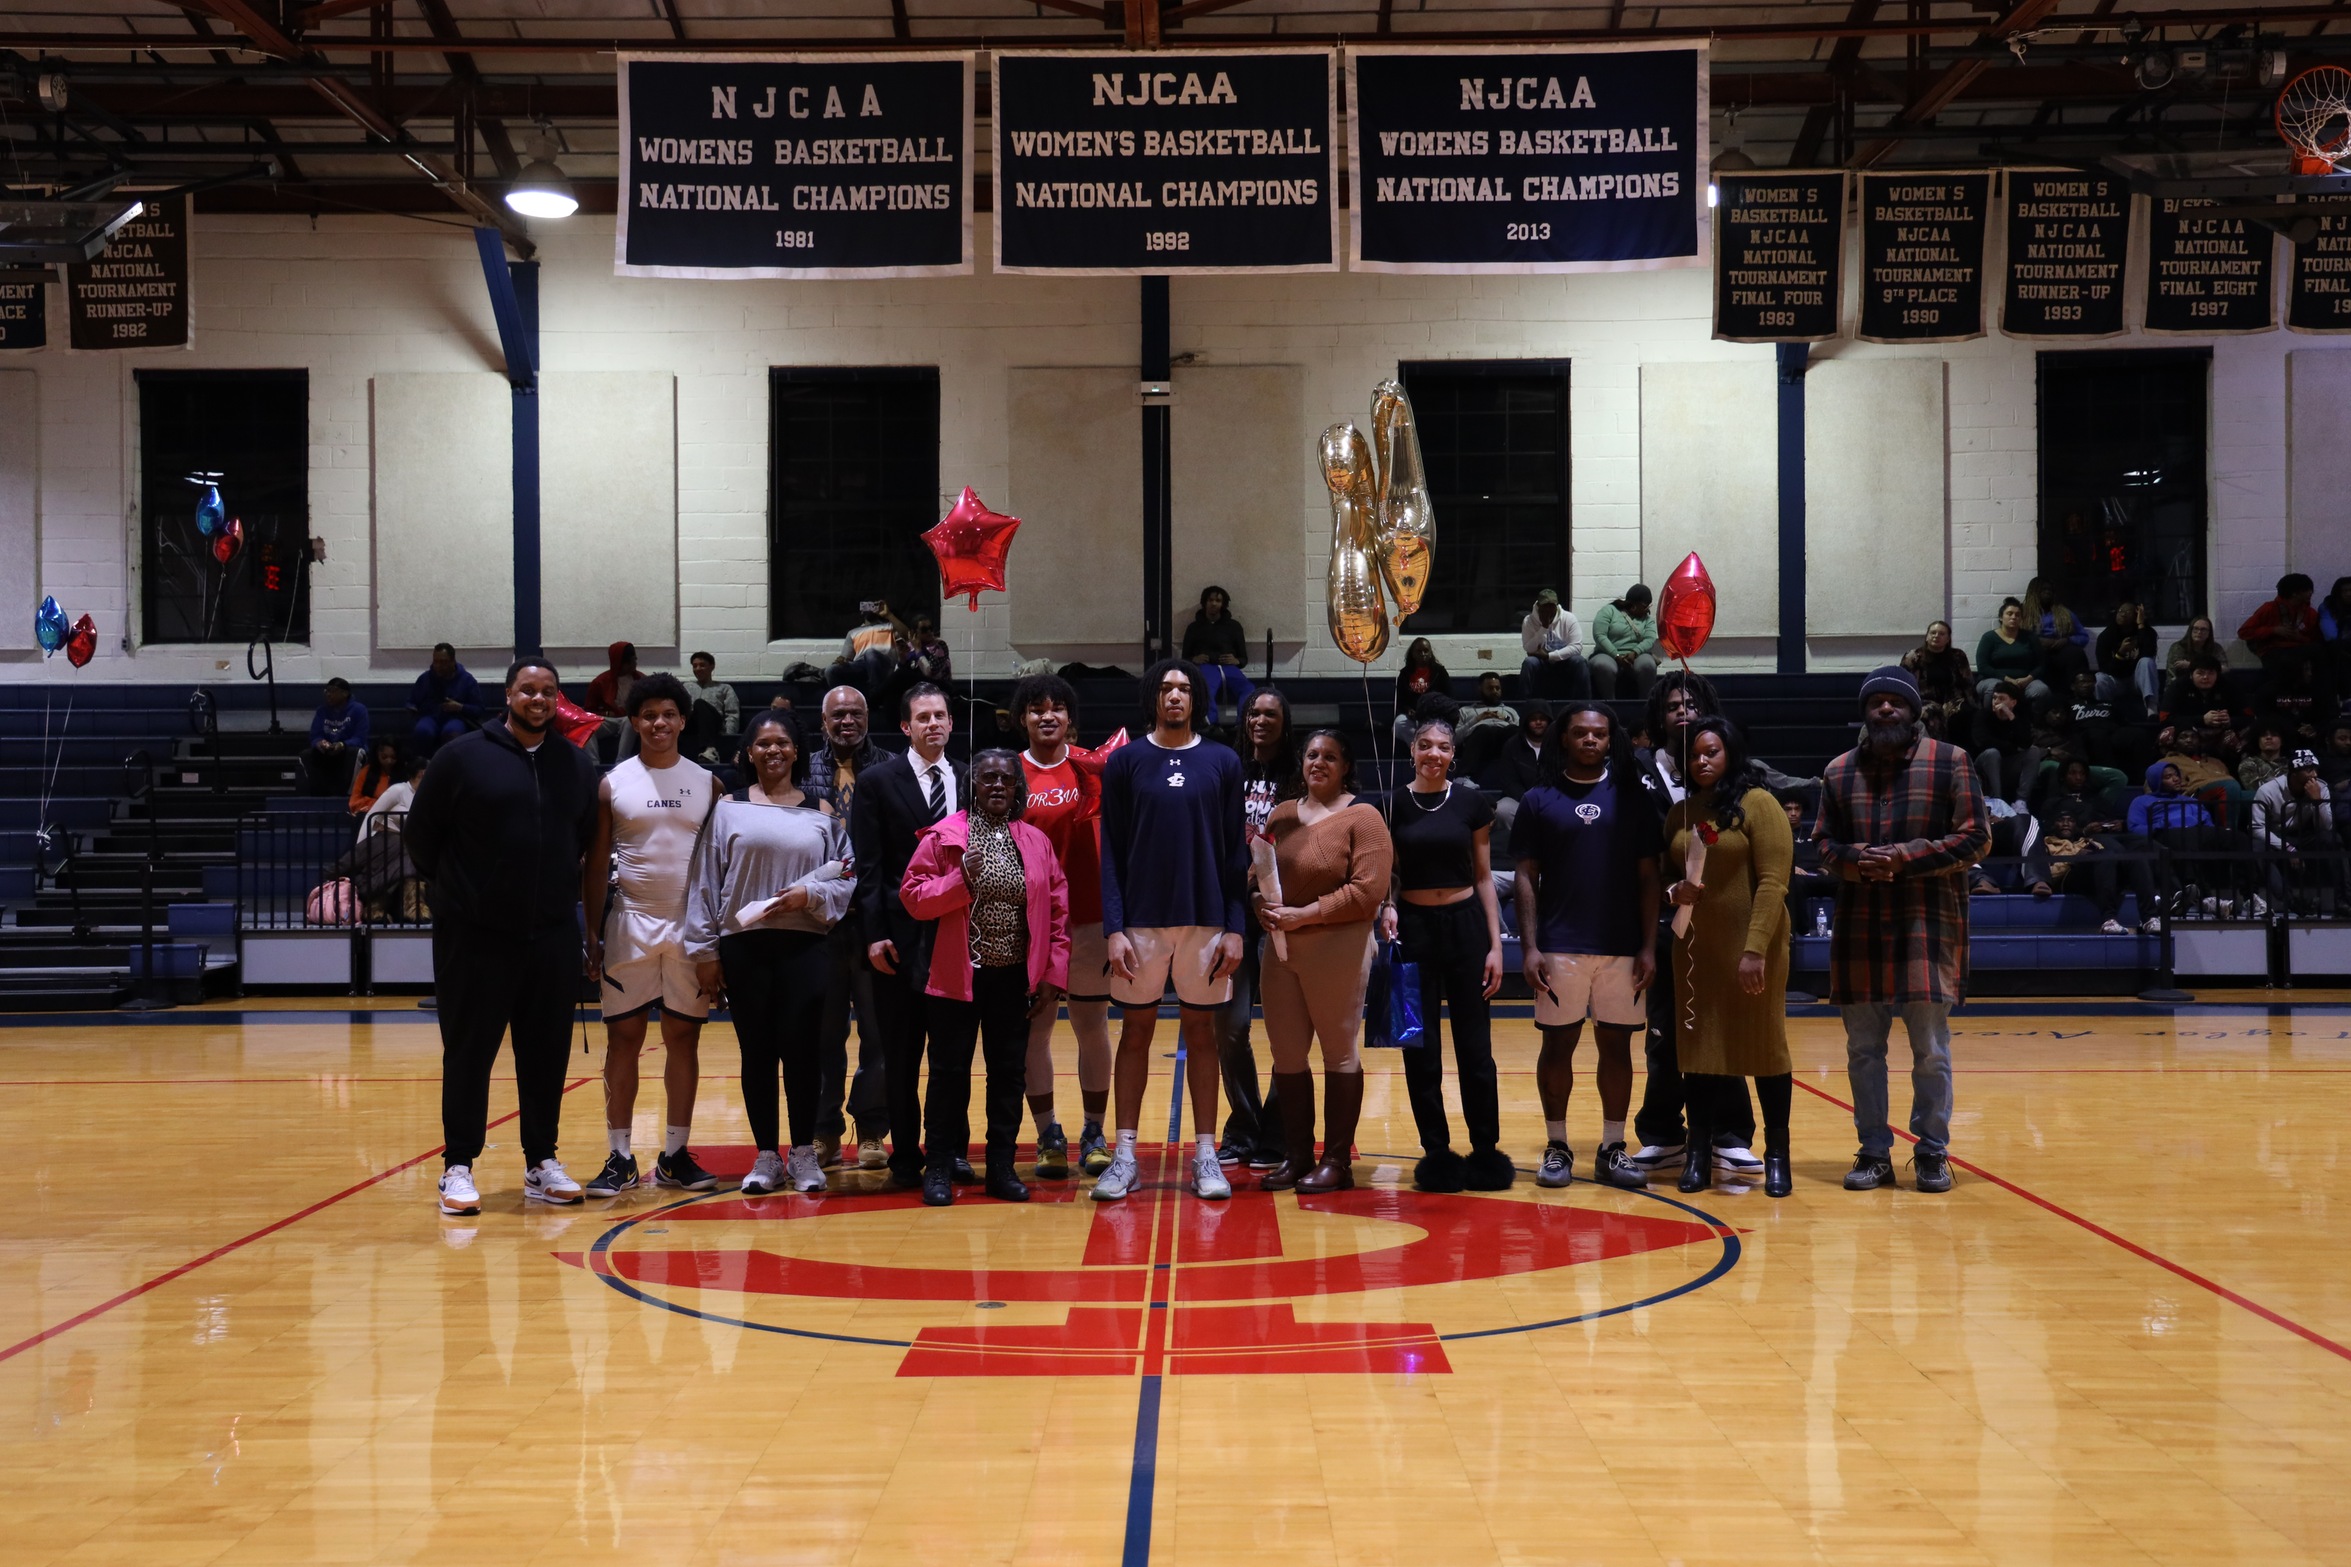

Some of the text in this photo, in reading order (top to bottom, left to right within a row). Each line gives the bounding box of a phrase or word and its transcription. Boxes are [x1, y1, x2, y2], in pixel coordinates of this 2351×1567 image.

[1093, 72, 1237, 106] NJCAA
[1460, 76, 1596, 111] NJCAA
[1011, 128, 1321, 157] WOMEN'S BASKETBALL
[1379, 127, 1678, 156] WOMENS BASKETBALL
[639, 137, 953, 165] WOMENS BASKETBALL
[1016, 179, 1318, 208] NATIONAL CHAMPIONS
[1376, 171, 1679, 202] NATIONAL CHAMPIONS
[640, 183, 949, 211] NATIONAL CHAMPIONS
[1731, 208, 1828, 224] BASKETBALL
[1875, 207, 1974, 222] BASKETBALL
[2018, 202, 2120, 218] BASKETBALL
[1507, 222, 1551, 241] 2013
[1750, 228, 1809, 244] NJCAA
[1897, 227, 1951, 242] NJCAA
[776, 231, 814, 248] 1981
[1146, 232, 1190, 251] 1992
[103, 244, 153, 258] NJCAA
[1886, 248, 1960, 262] NATIONAL
[2028, 244, 2105, 259] NATIONAL
[2175, 240, 2248, 255] NATIONAL
[1743, 250, 1816, 265] NATIONAL
[91, 264, 165, 278] NATIONAL
[1873, 268, 1973, 283] TOURNAMENT
[2014, 263, 2119, 280] TOURNAMENT
[2160, 260, 2262, 276] TOURNAMENT
[1729, 270, 1827, 286] TOURNAMENT
[78, 283, 177, 298] TOURNAMENT
[2018, 285, 2111, 300] RUNNER-UP
[2160, 281, 2258, 296] FINAL EIGHT
[2304, 279, 2350, 293] FINAL
[1732, 291, 1823, 306] FINAL FOUR
[1907, 288, 1958, 303] PLACE
[86, 303, 173, 318] RUNNER-UP
[2044, 306, 2082, 320] 1993
[2190, 301, 2229, 316] 1997
[1759, 311, 1795, 326] 1983
[1902, 309, 1940, 324] 1990
[112, 323, 147, 338] 1982
[647, 800, 682, 808] CANES
